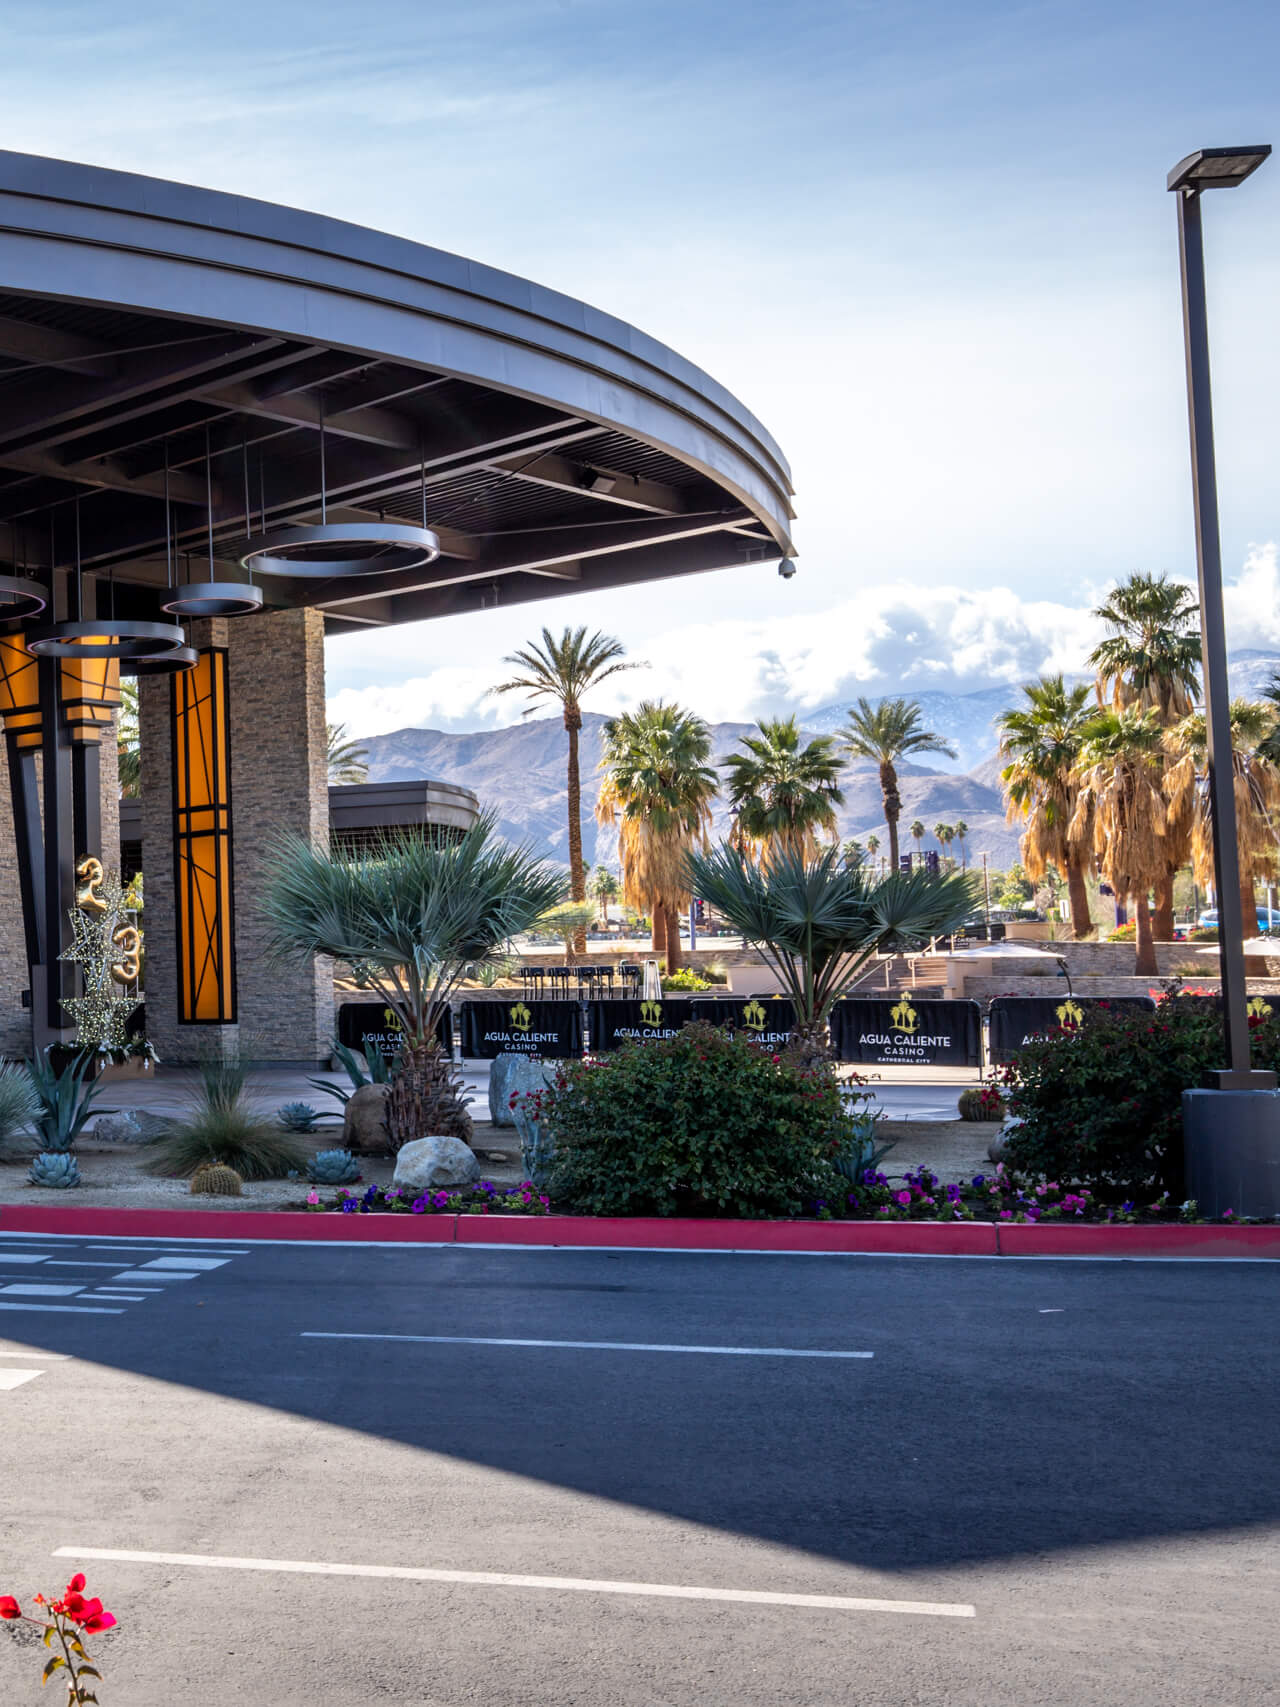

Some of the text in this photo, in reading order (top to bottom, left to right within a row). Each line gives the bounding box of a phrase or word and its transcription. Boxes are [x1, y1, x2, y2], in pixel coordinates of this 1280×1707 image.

[76, 854, 107, 912] 2
[111, 923, 140, 985] 3
[484, 1032, 559, 1043] AGUA CALIENTE
[642, 1028, 680, 1039] CALIEN
[747, 1032, 790, 1043] CALIENT
[859, 1033, 951, 1047] AGUA CALIENTE
[504, 1043, 537, 1051] CASINO
[884, 1046, 924, 1056] CASINO
